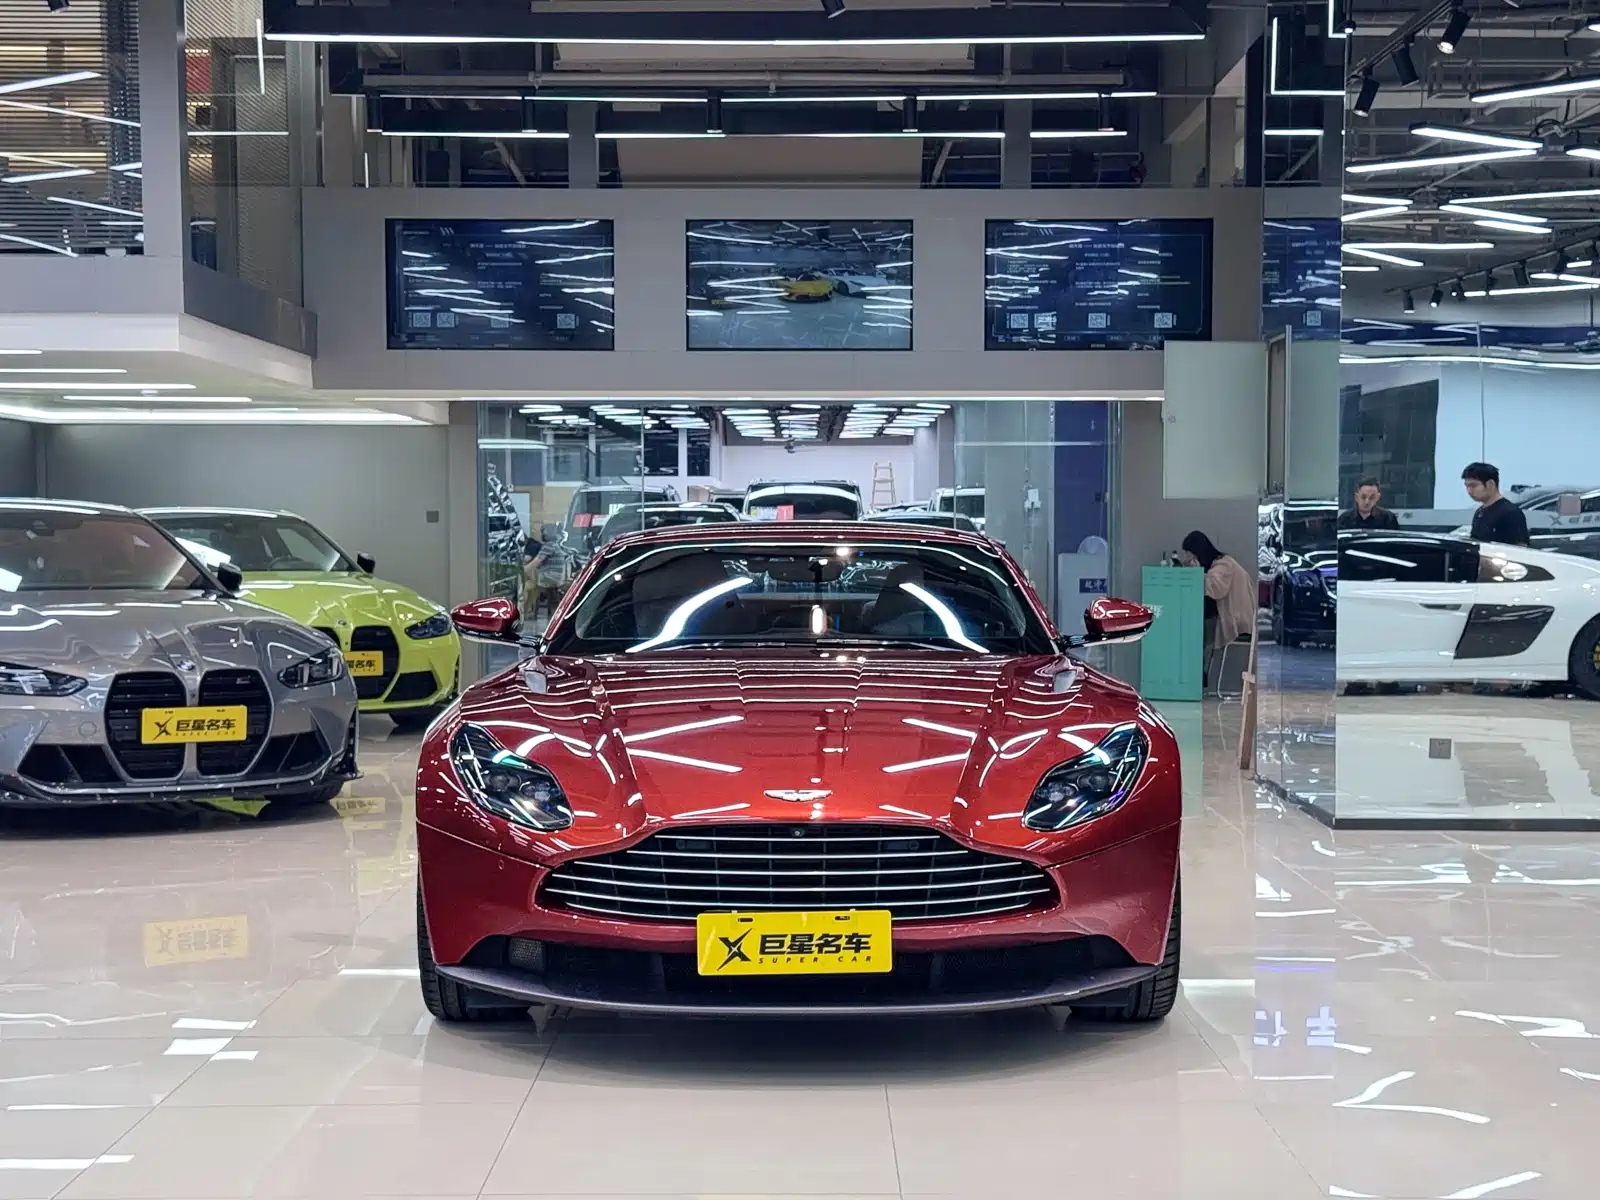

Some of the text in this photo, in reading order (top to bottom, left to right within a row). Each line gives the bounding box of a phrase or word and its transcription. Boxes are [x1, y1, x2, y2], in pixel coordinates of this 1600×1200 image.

[176, 718, 236, 732] 巨星名车
[758, 933, 872, 956] 巨星名车
[758, 955, 872, 964] SUPER CAR
